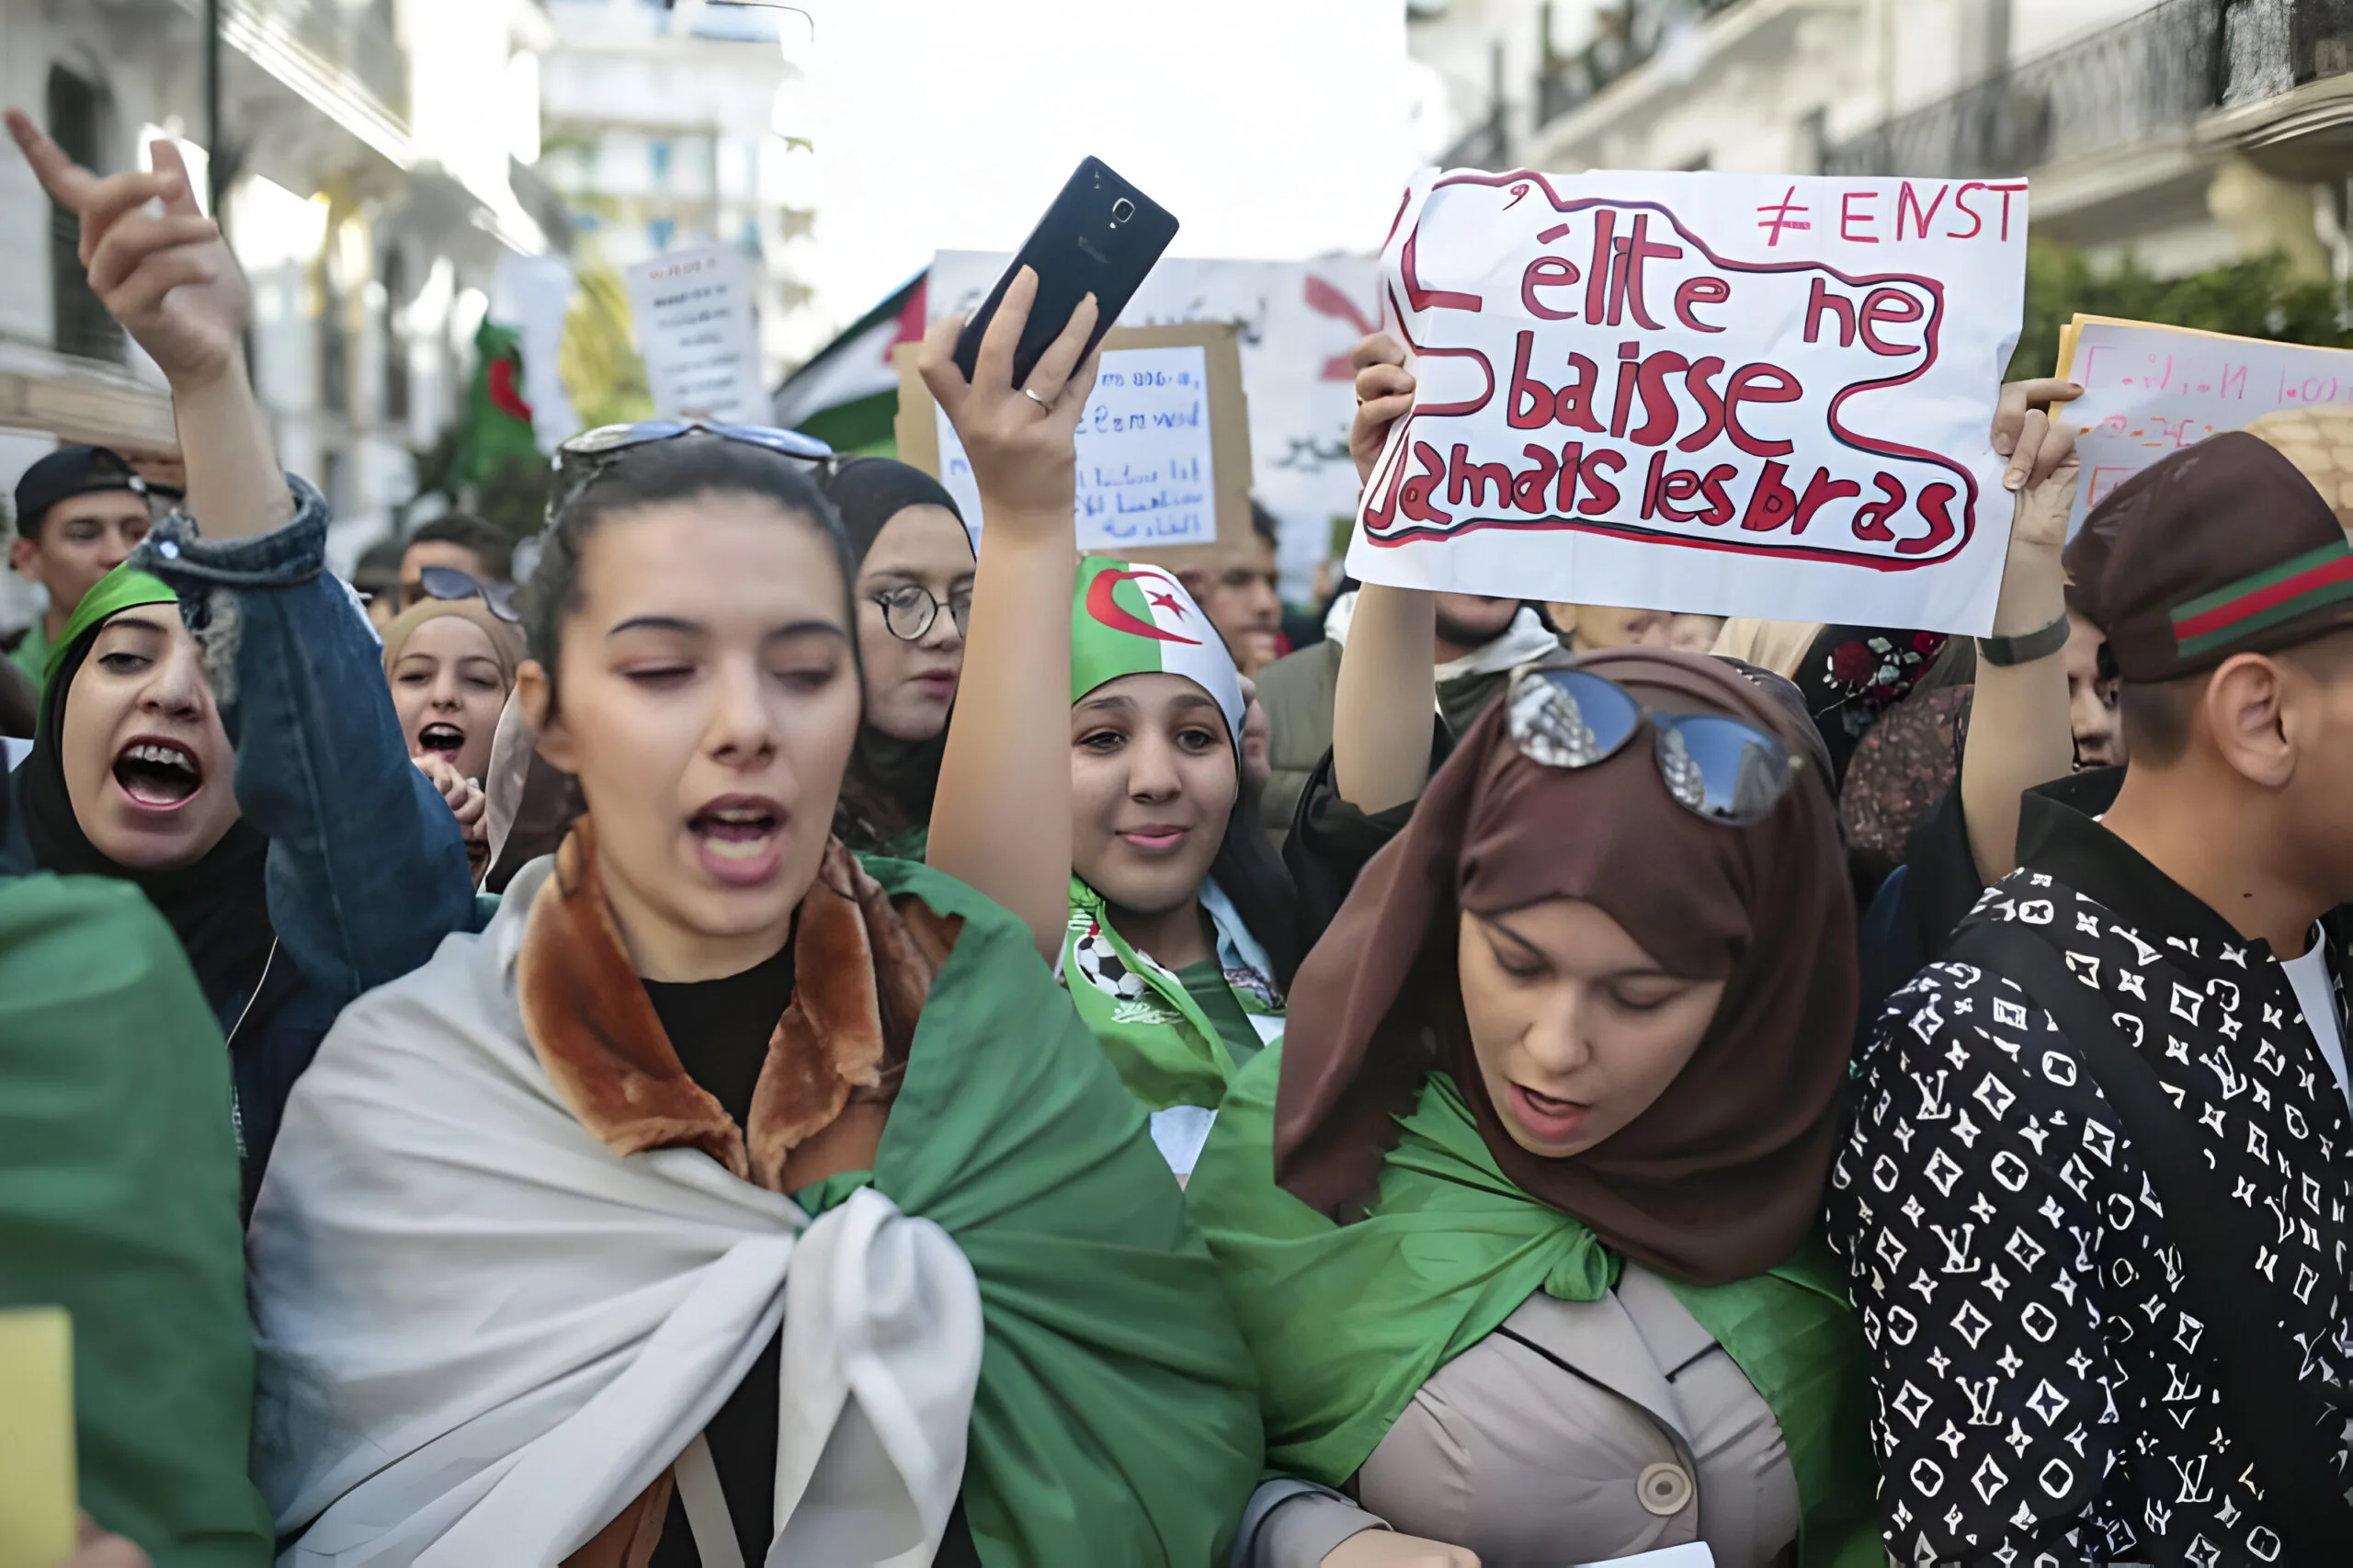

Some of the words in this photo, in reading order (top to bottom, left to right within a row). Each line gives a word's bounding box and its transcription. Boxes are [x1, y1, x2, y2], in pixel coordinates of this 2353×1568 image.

[1840, 180, 2028, 244] ENST
[1803, 277, 1924, 356] ne
[1506, 330, 1803, 459] baisse
[1640, 449, 1738, 526] les
[1740, 460, 1958, 553] bras
